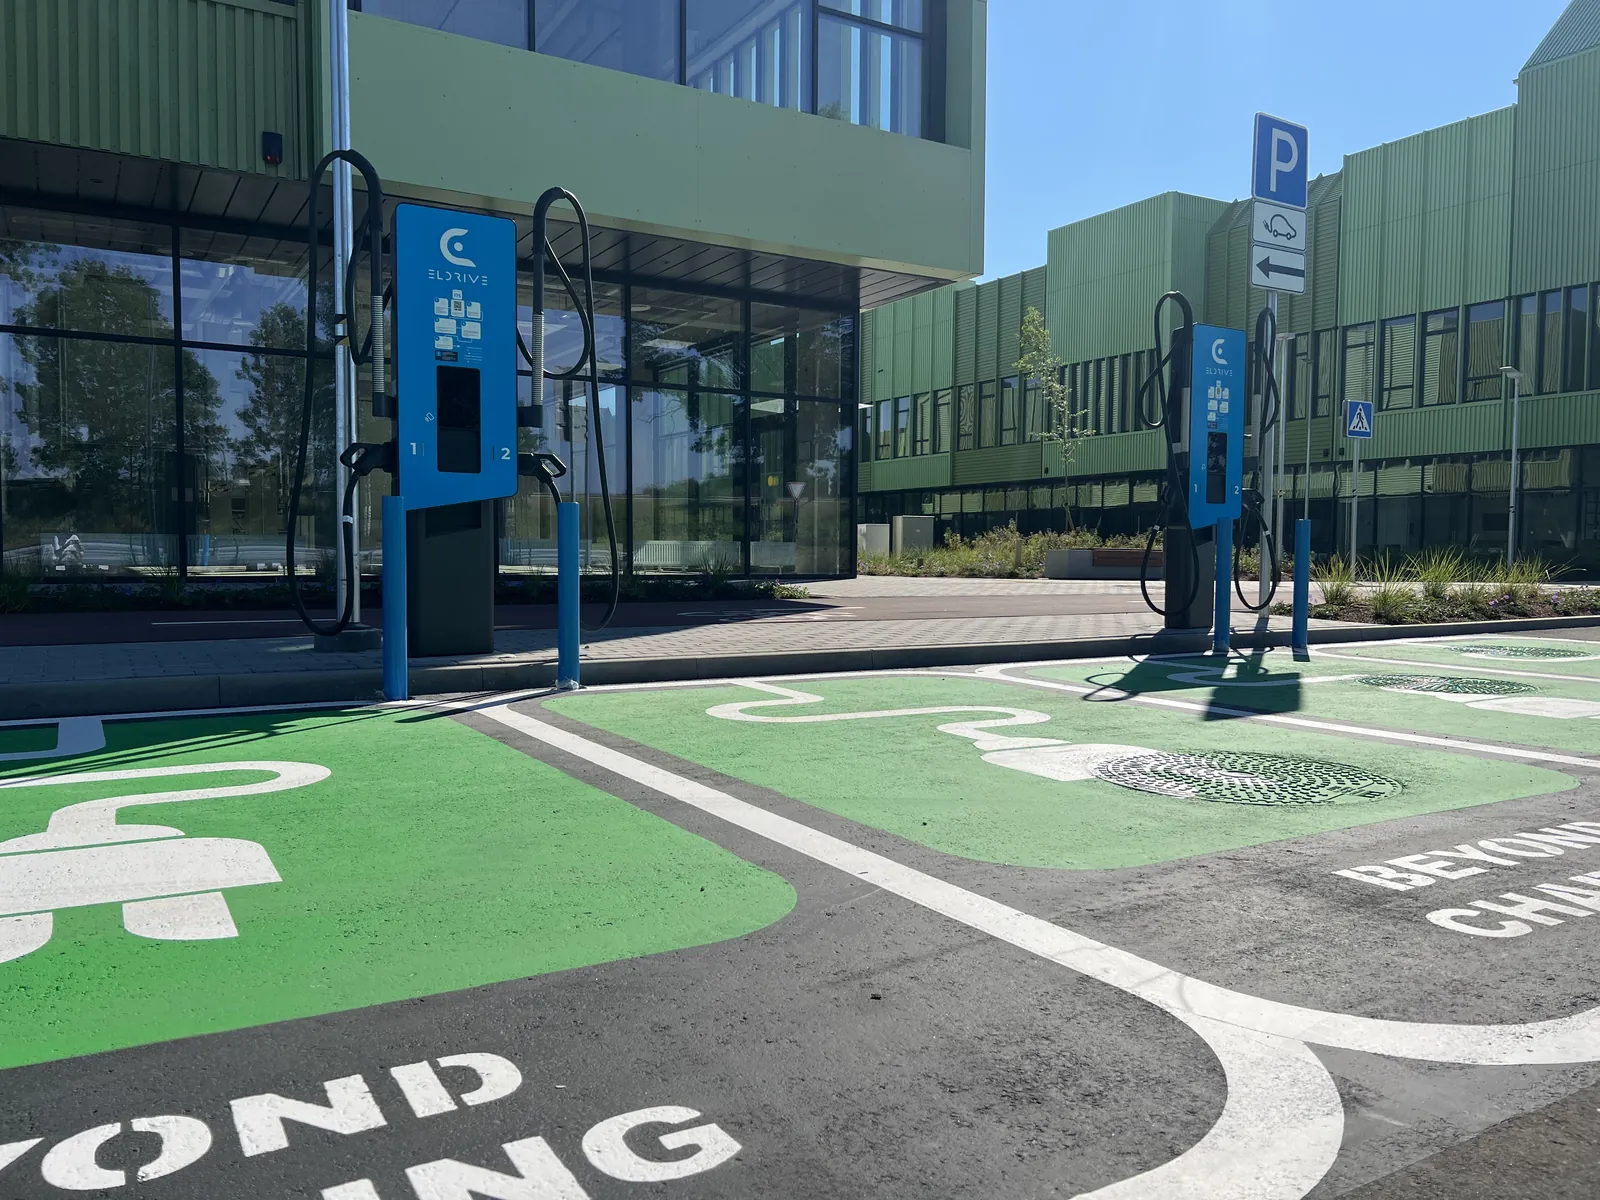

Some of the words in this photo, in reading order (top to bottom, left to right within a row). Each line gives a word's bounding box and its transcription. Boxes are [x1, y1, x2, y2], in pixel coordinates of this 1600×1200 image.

[1270, 128, 1299, 192] P
[428, 268, 488, 286] ELDRIVE
[1205, 366, 1233, 377] ELDRIVE
[410, 442, 417, 455] 1
[501, 447, 511, 460] 2
[1194, 483, 1198, 493] 1
[1234, 485, 1240, 495] 2
[0, 1052, 523, 1190] OND
